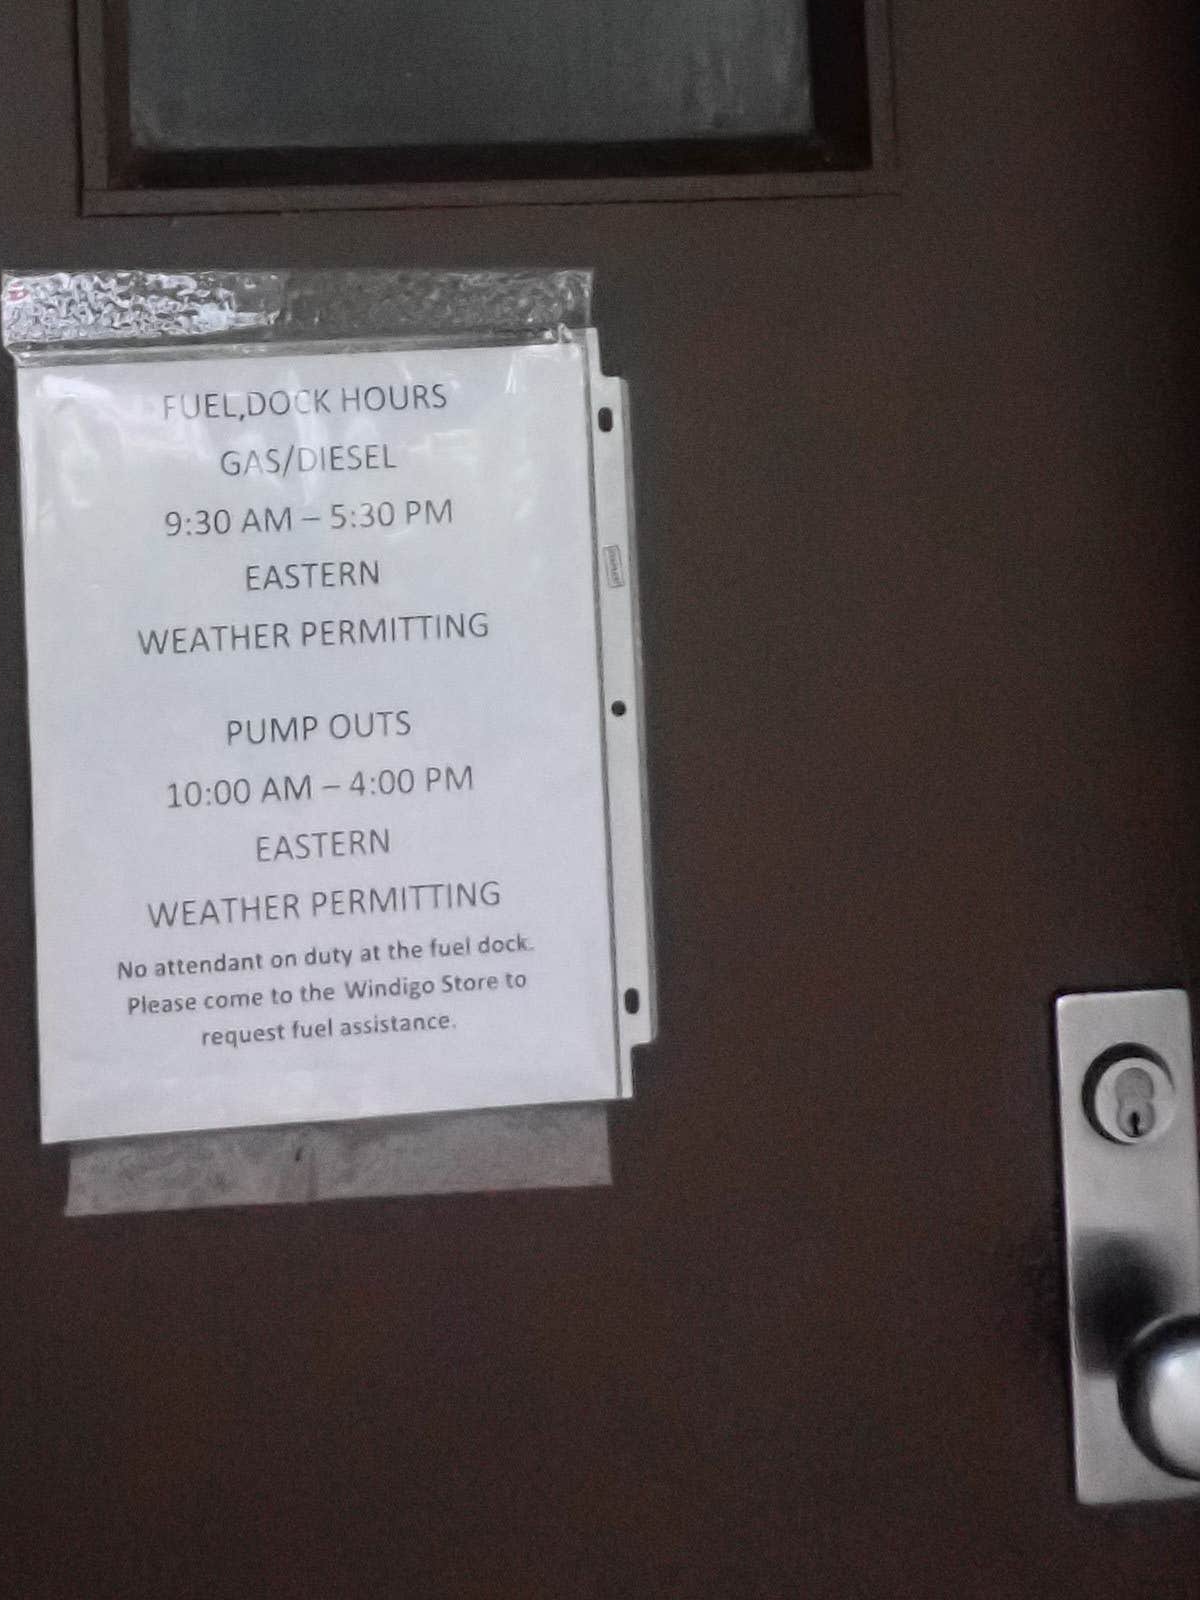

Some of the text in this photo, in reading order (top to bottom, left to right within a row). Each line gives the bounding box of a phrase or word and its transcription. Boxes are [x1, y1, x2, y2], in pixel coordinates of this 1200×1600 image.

[341, 383, 447, 413] HOURS
[221, 443, 398, 479] GAS/DIESEL
[165, 508, 232, 538] 9:30
[240, 506, 293, 536] AM
[329, 502, 397, 530] 5:30
[405, 498, 453, 527] PM
[245, 561, 381, 592] EASTERN
[137, 611, 490, 657] WEATHER PERMITTING
[226, 710, 412, 747] PUMP OUTS
[167, 777, 251, 810] 10:00
[261, 774, 312, 802] AM
[349, 769, 415, 796] 4:00
[425, 764, 474, 793] PM
[256, 829, 391, 863] EASTERN
[147, 880, 502, 929] WEATHER PERMITTING
[117, 932, 535, 981] No attendant on duty at the fuel dock.
[128, 970, 527, 1017] Please come to the Windigo Store to
[200, 1011, 458, 1050] request fuel assistance.
